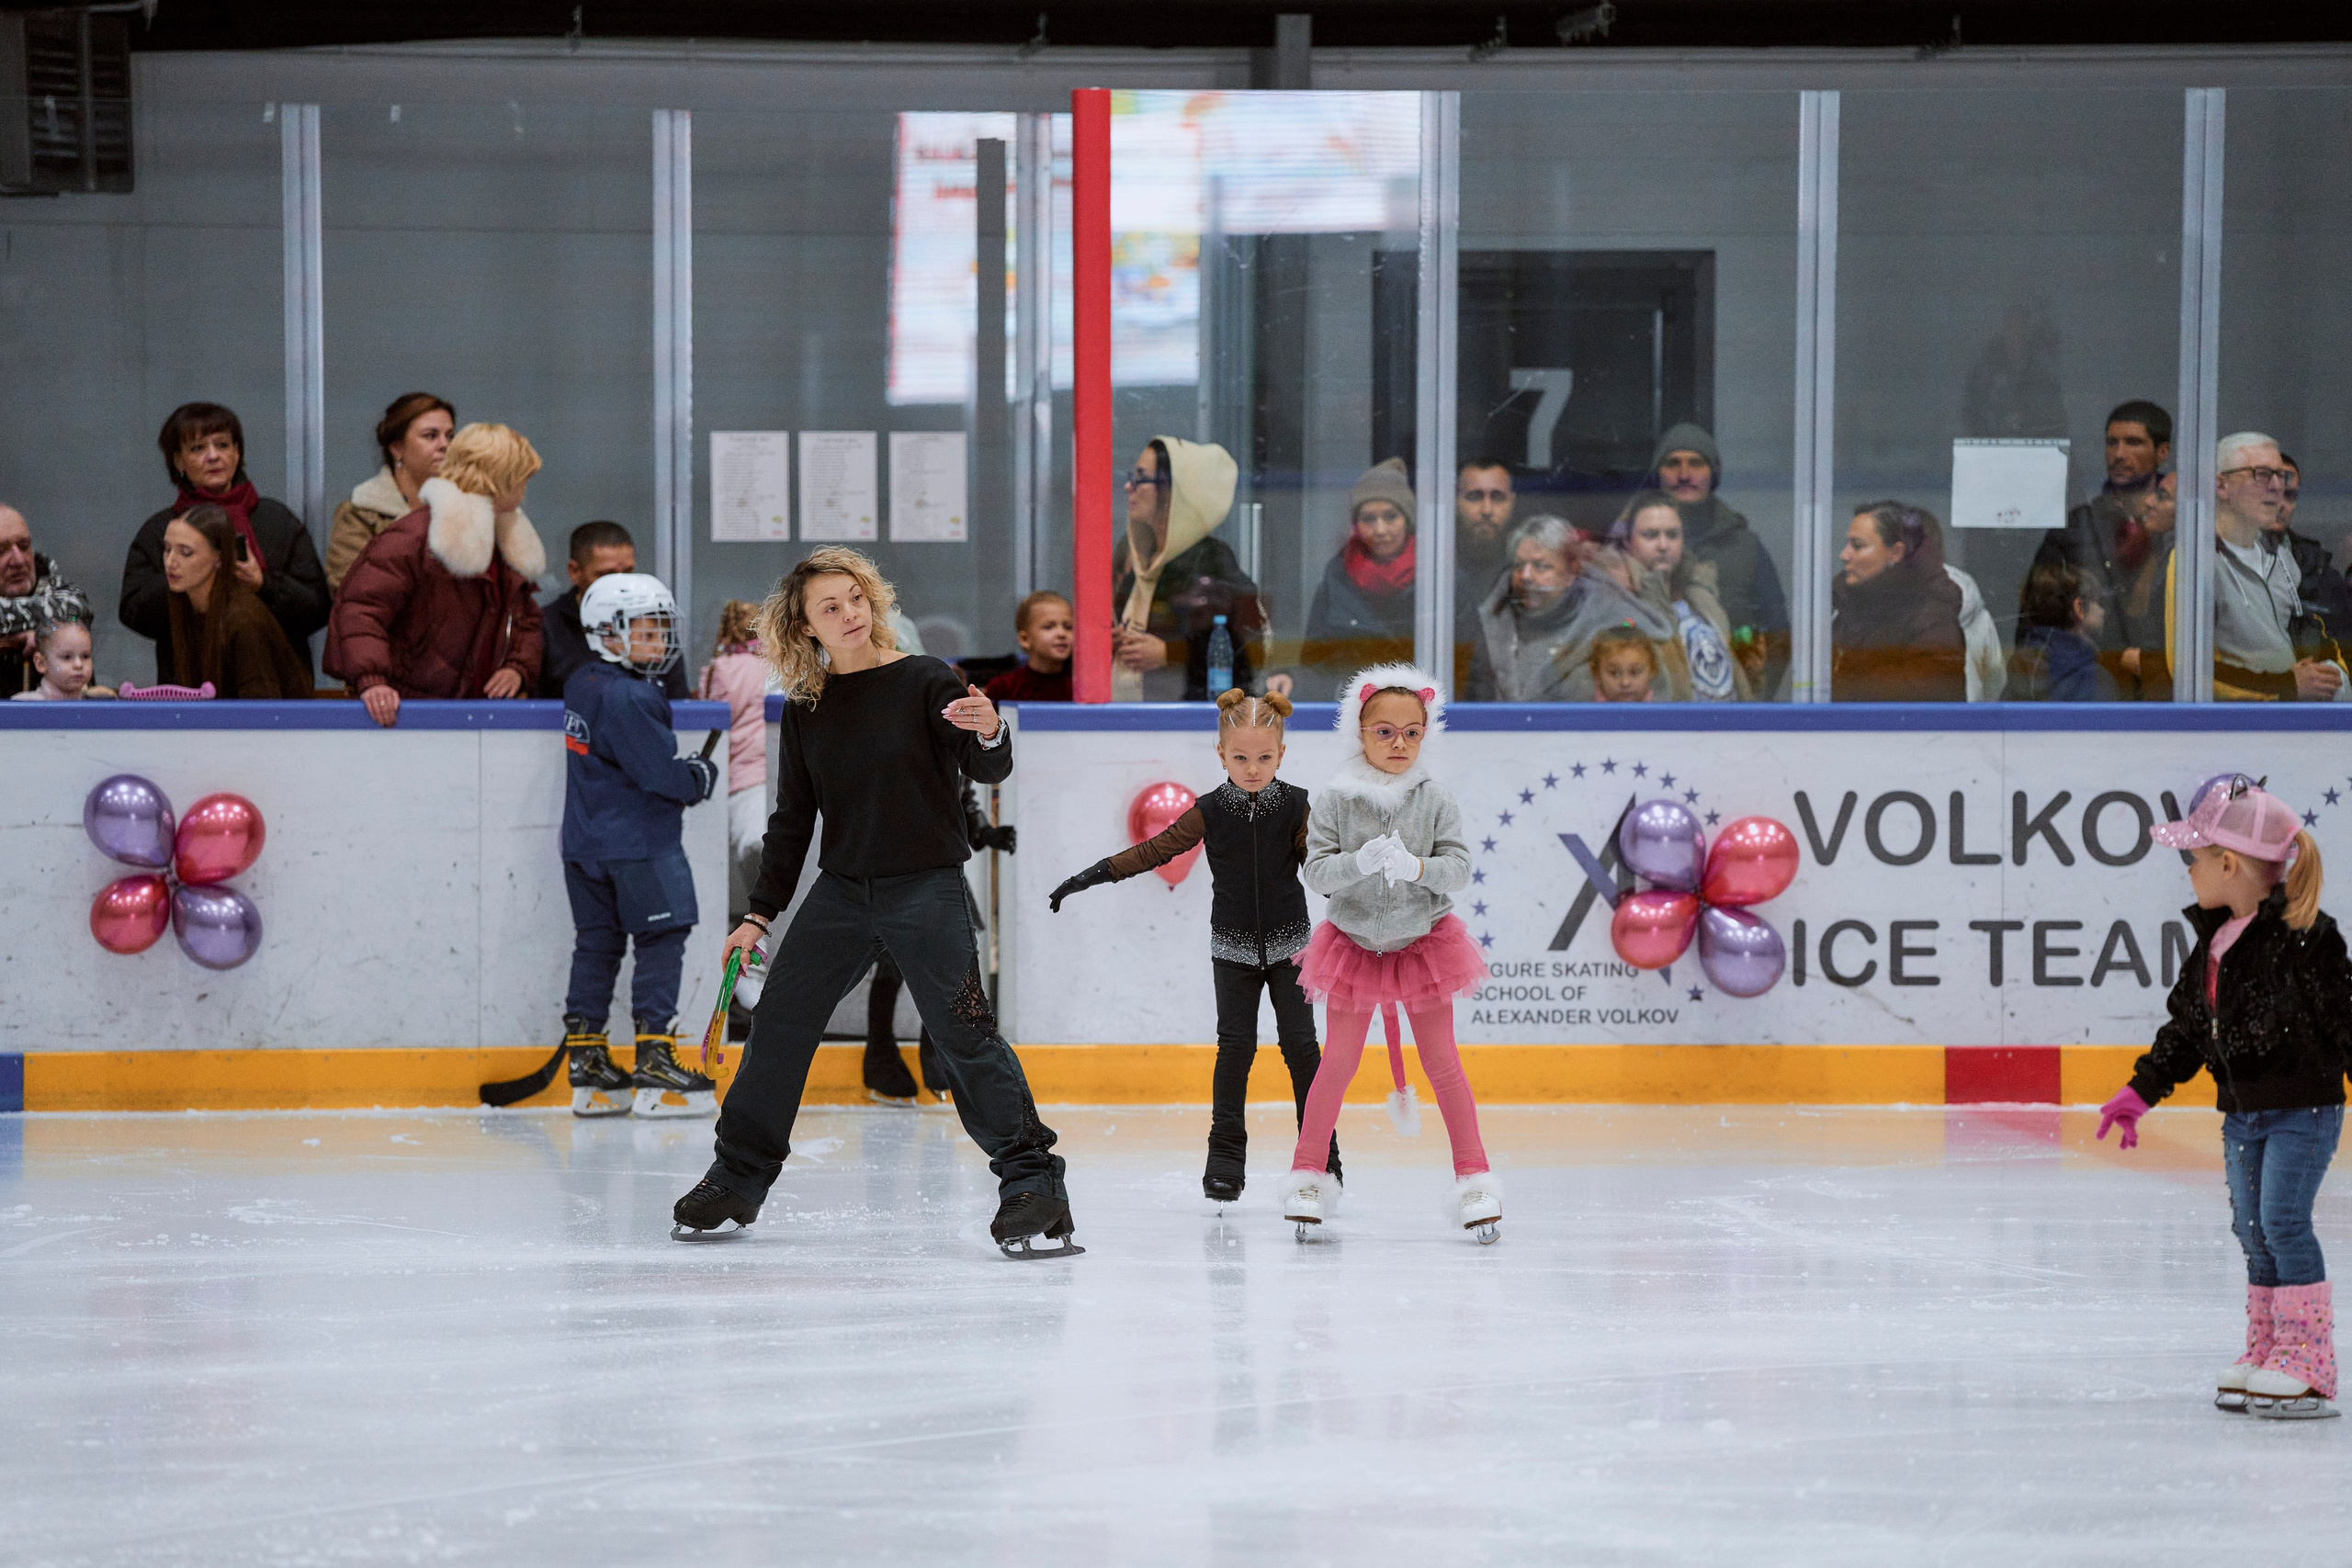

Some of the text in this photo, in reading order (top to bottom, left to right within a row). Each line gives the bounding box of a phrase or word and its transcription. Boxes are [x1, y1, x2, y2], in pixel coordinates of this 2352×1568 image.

[1509, 367, 1574, 469] 7
[1792, 919, 1941, 988] ICE
[1486, 962, 1545, 978] GURE
[1561, 986, 1588, 1001] OF
[1472, 1009, 1679, 1025] ALEXANDER VOLKOV
